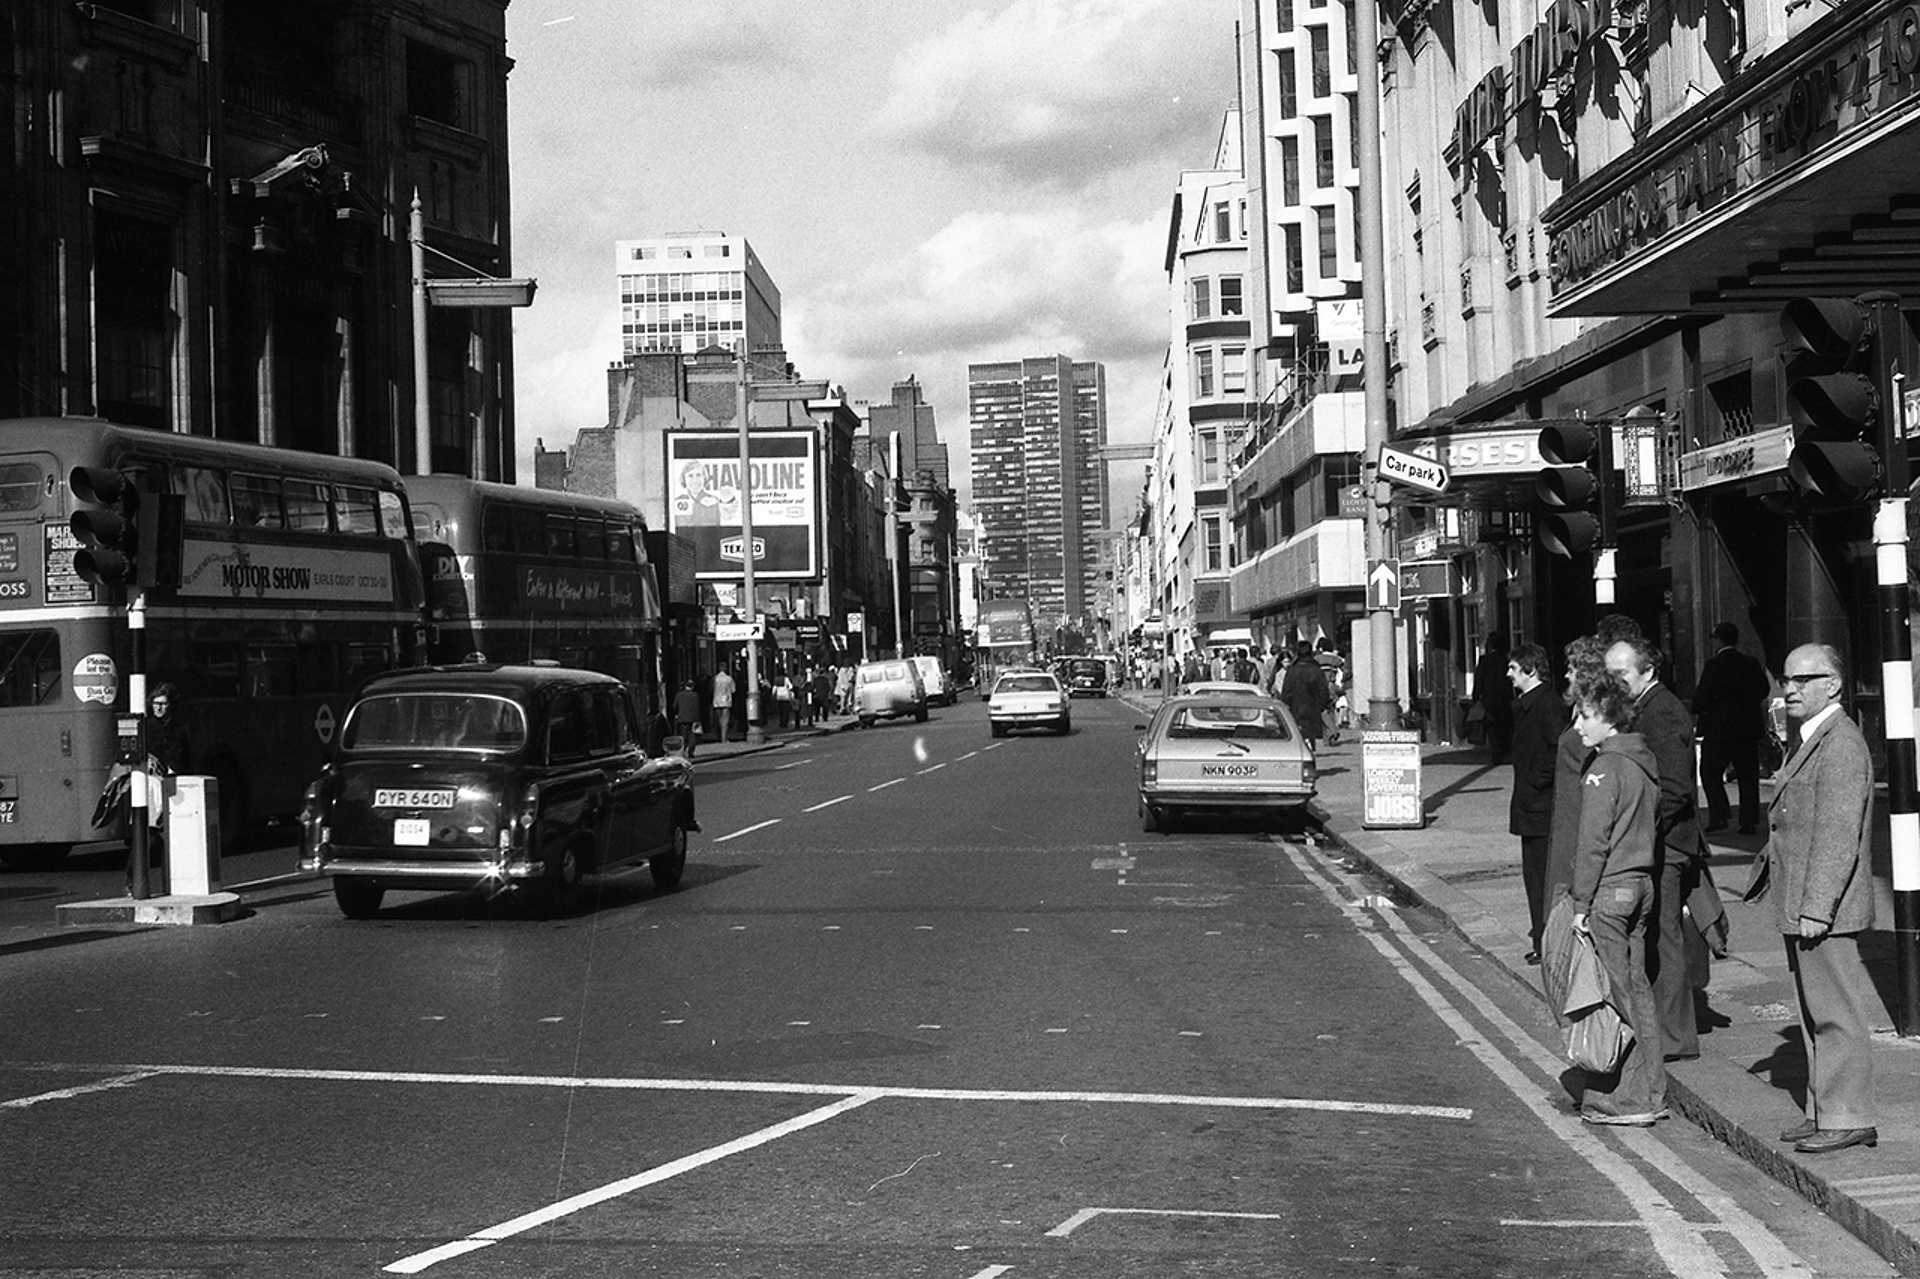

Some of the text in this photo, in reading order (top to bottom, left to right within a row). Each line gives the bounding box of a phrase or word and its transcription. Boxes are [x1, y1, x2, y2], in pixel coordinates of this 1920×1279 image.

[704, 462, 805, 490] HAVOLINE
[1386, 455, 1435, 482] Car park
[724, 543, 762, 554] TEXO
[222, 563, 270, 589] MOTOR
[272, 566, 311, 589] SHOW
[1202, 765, 1258, 776] NKN 903P
[411, 792, 451, 806] 640N
[1368, 795, 1415, 819] JOBS
